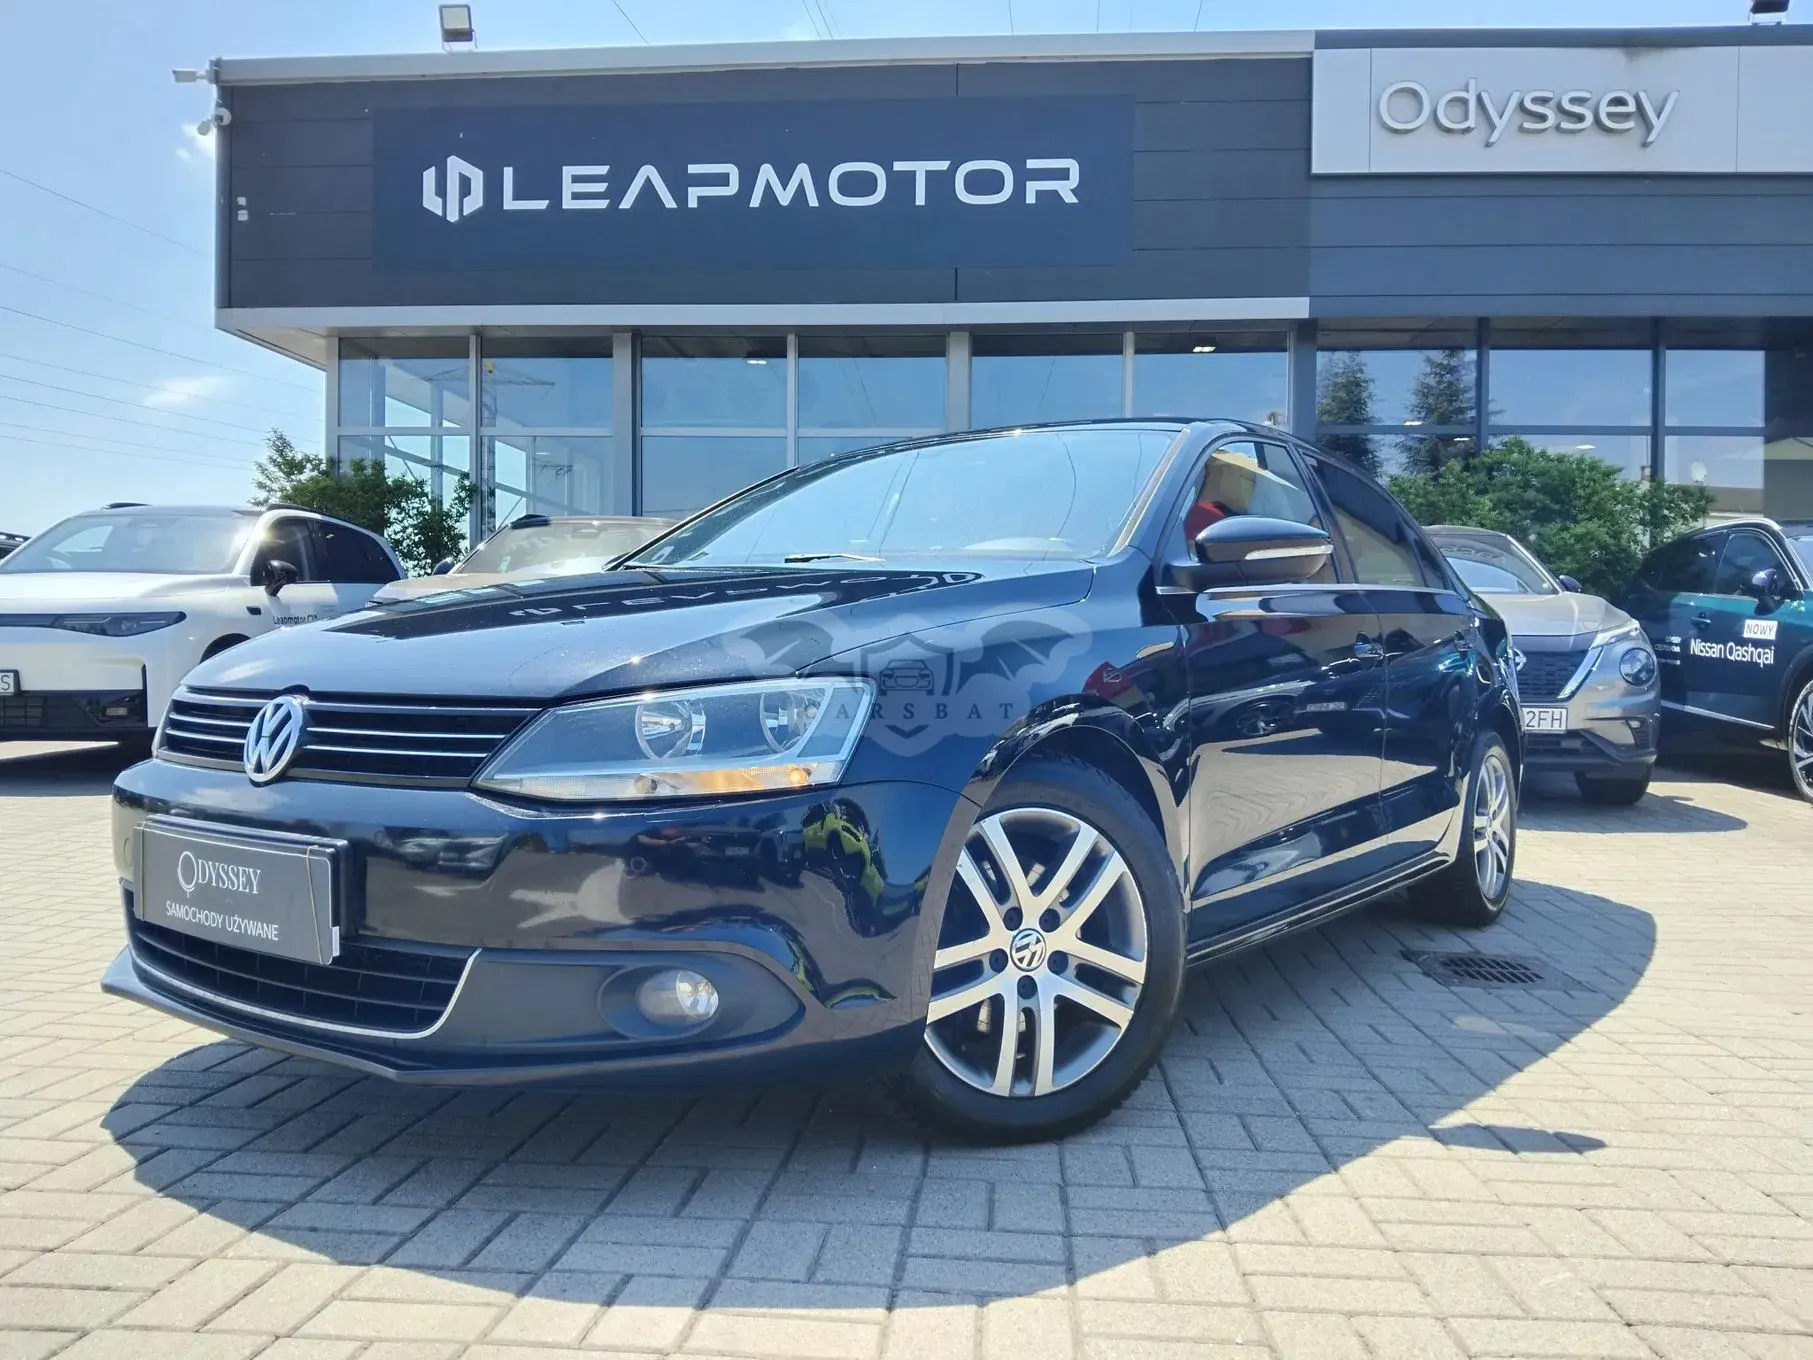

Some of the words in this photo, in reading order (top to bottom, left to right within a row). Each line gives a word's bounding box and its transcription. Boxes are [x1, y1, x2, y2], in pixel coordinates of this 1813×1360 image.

[1378, 77, 1680, 148] Odyssey
[503, 159, 1080, 210] LEAPMOTOR
[1746, 623, 1775, 635] NOWY
[1690, 638, 1724, 658] Nissan
[1726, 641, 1775, 668] Qashqai
[1525, 710, 1563, 728] 2FH
[177, 851, 261, 898] ODYSSEY
[165, 900, 225, 929] SAMOCHODY
[225, 914, 279, 941] UŻYWANE
